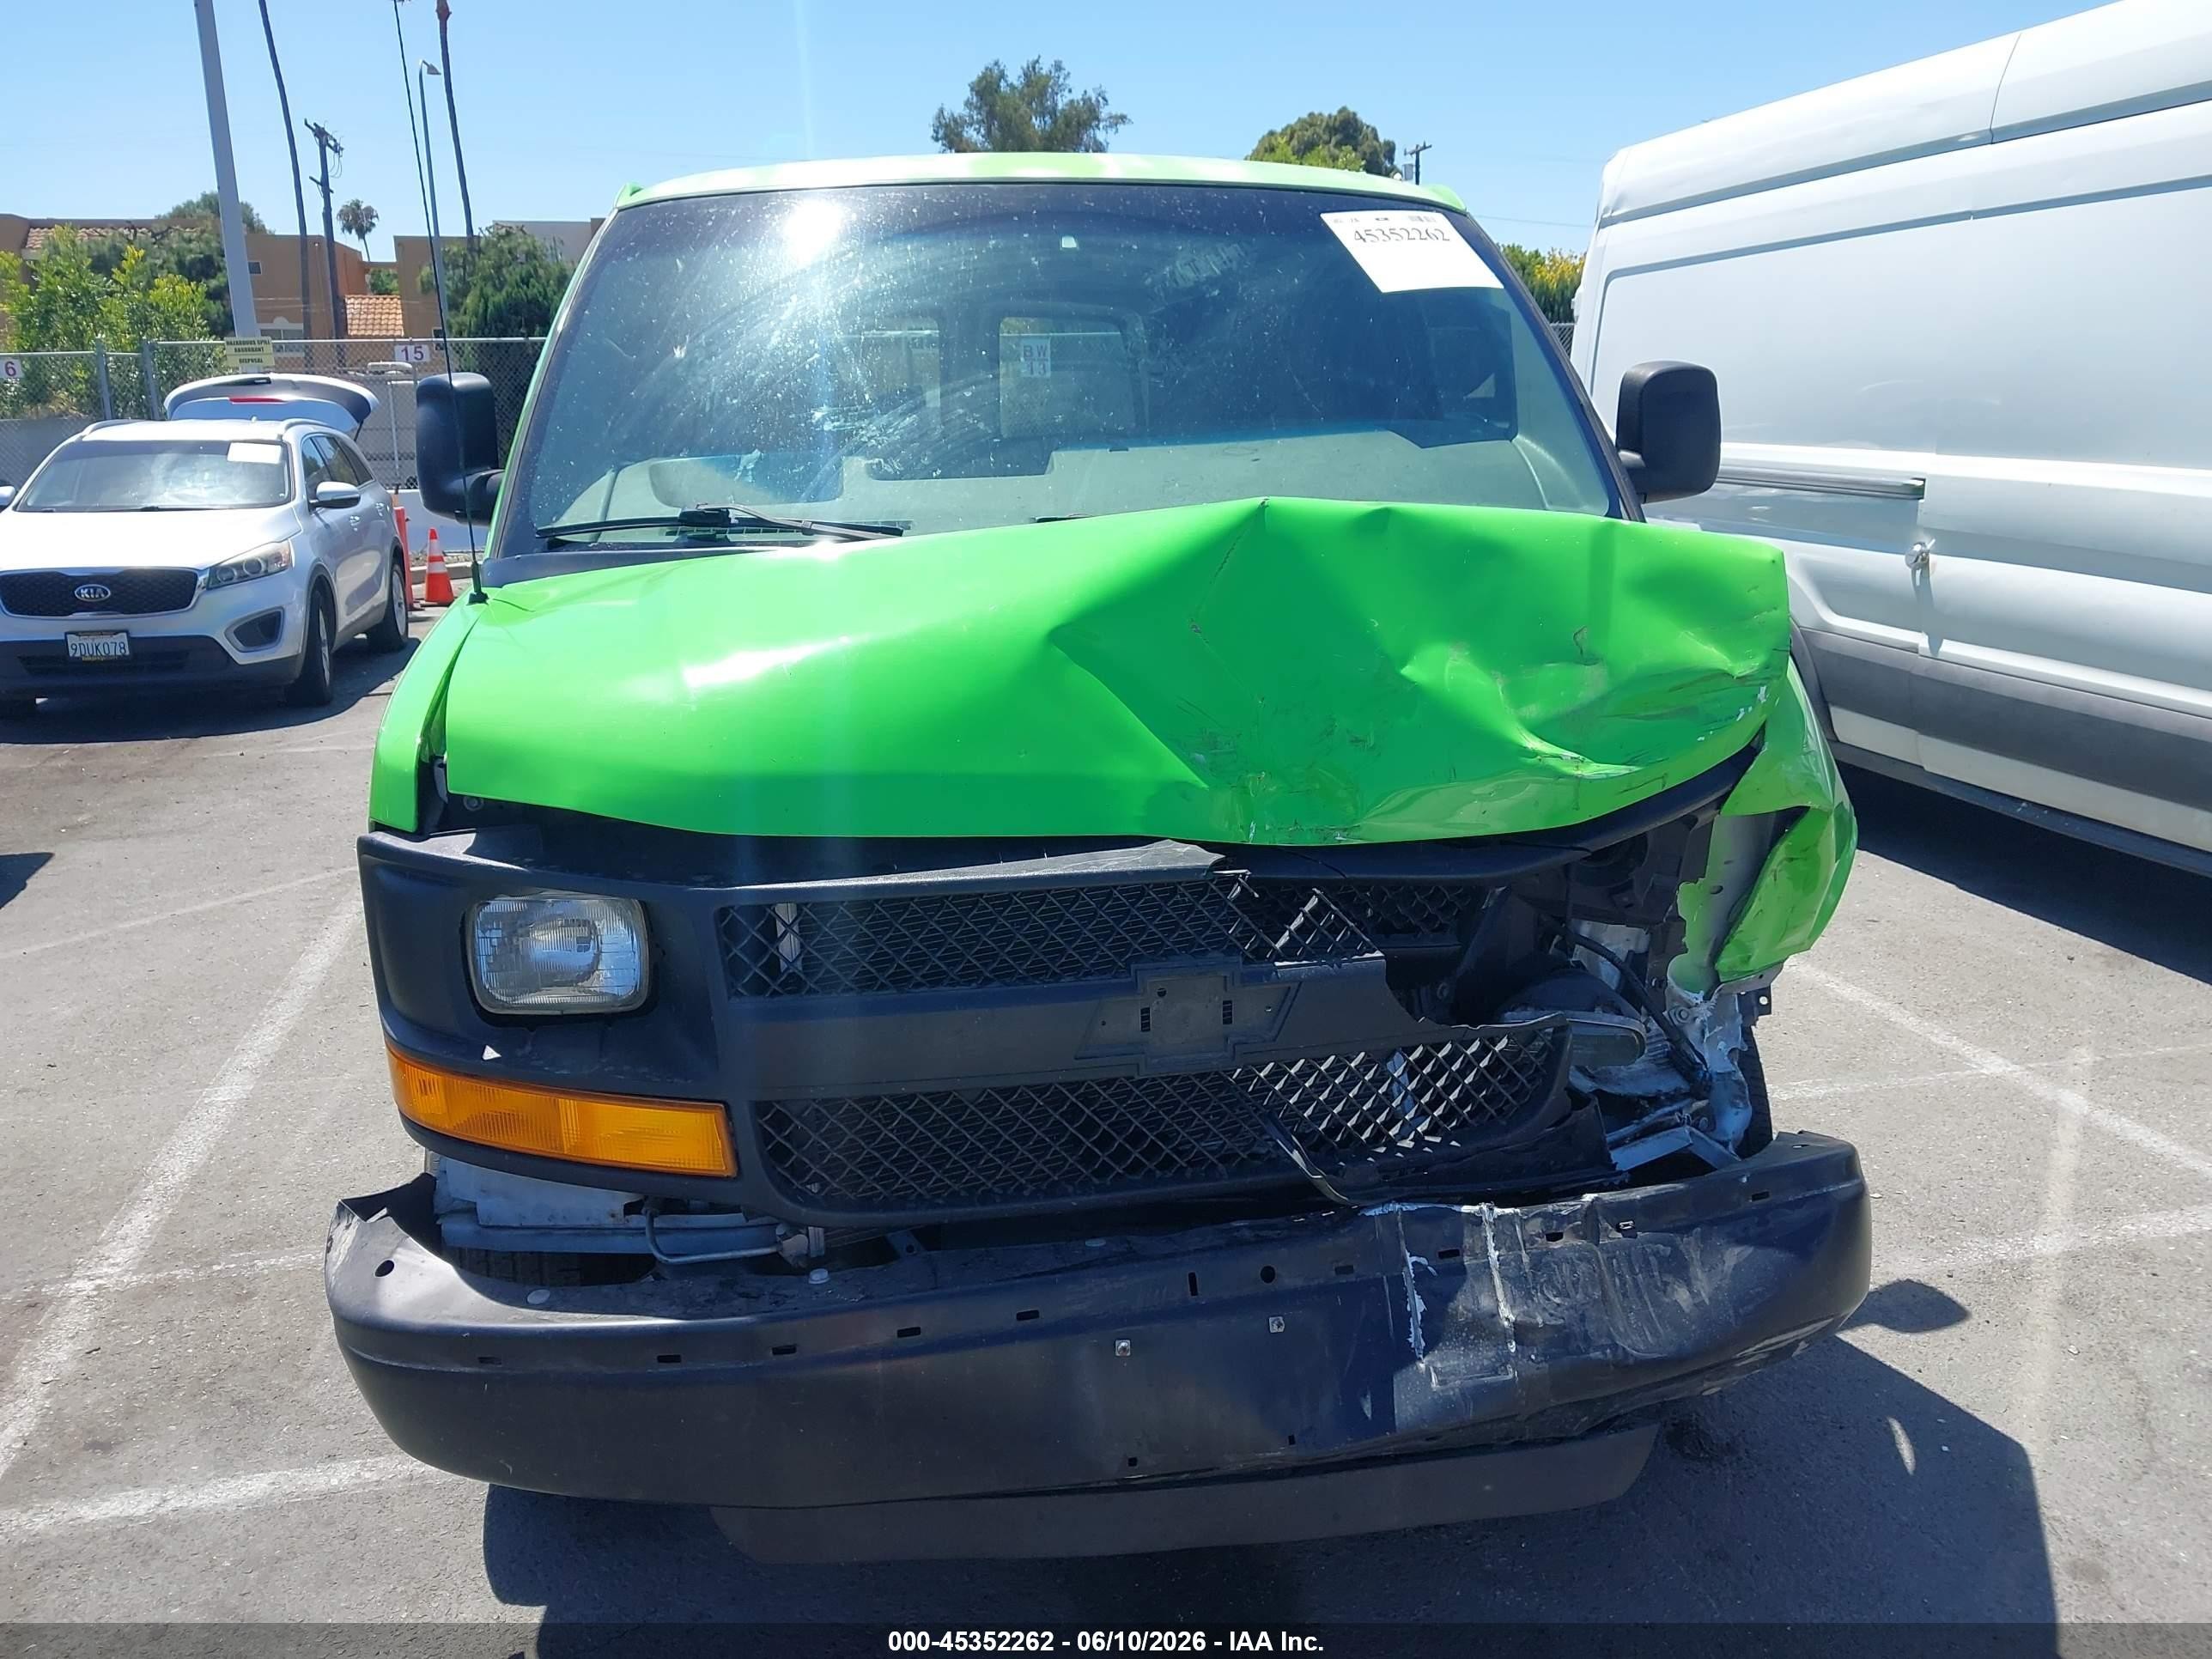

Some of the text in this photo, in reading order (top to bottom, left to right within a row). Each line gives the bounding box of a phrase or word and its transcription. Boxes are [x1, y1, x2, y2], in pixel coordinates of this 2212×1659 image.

[1354, 228, 1450, 243] 45352262
[401, 345, 424, 361] 15
[4, 361, 17, 377] 6
[80, 587, 105, 599] KIA
[70, 641, 126, 658] 9DUK078
